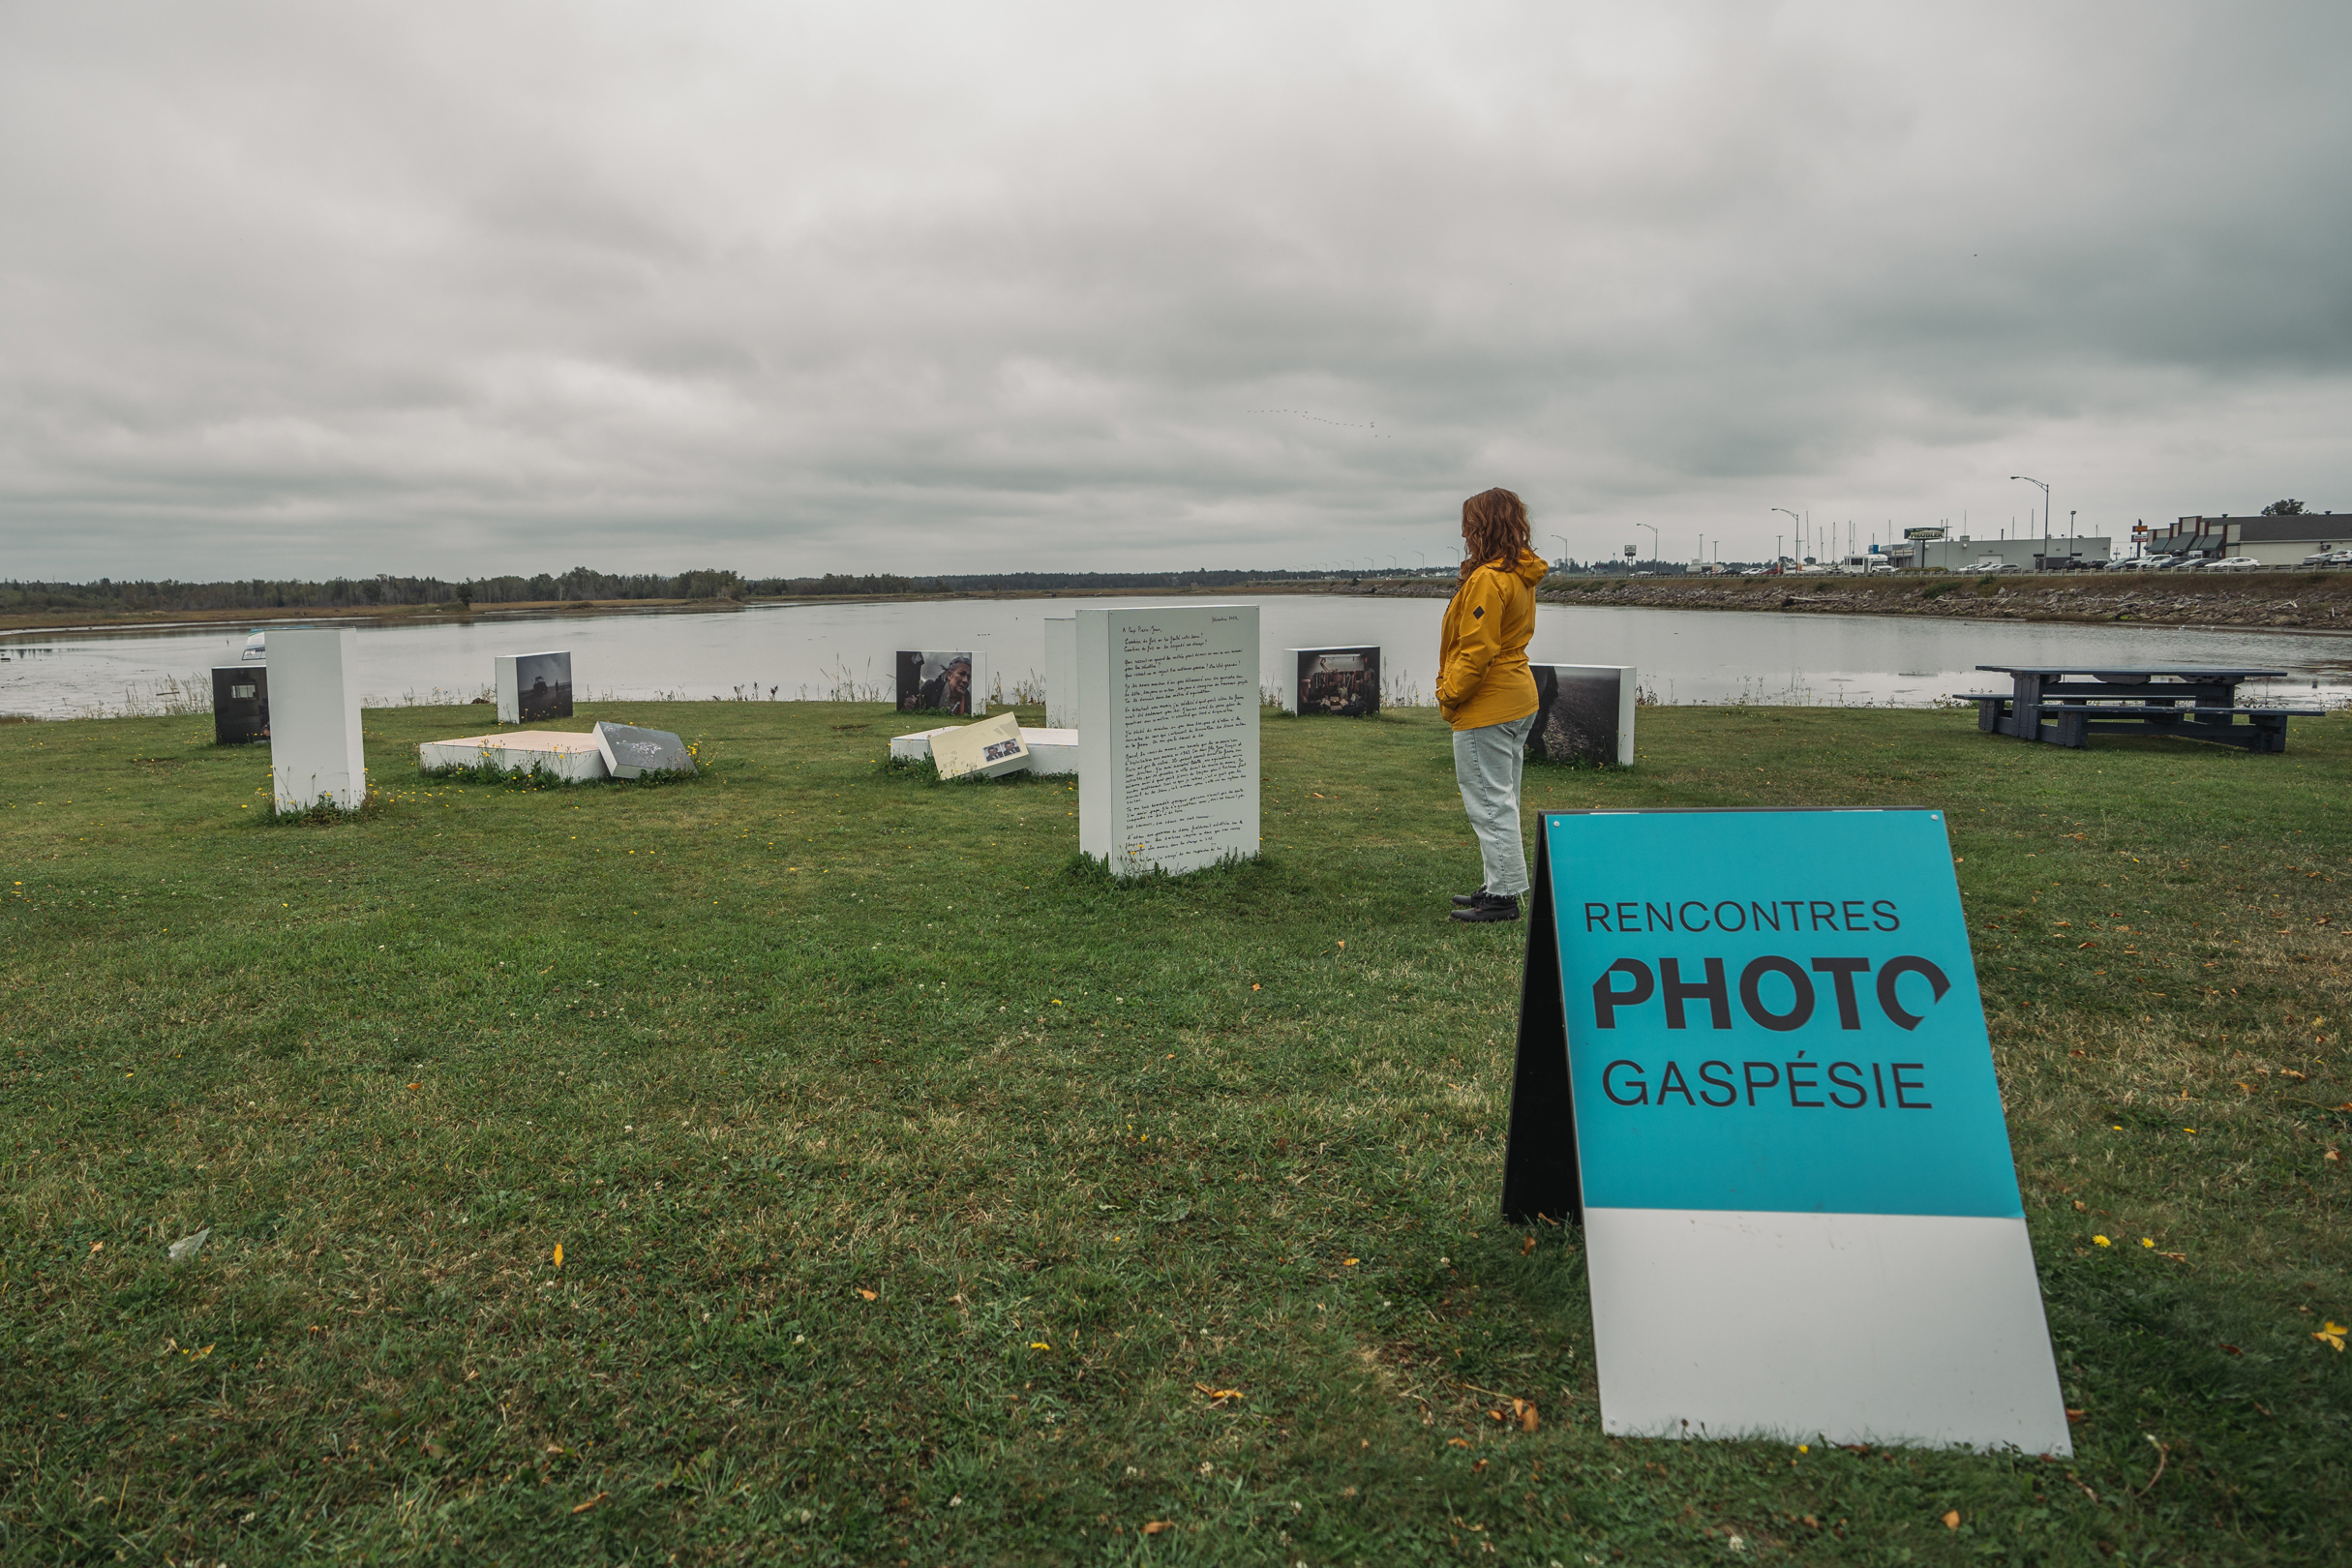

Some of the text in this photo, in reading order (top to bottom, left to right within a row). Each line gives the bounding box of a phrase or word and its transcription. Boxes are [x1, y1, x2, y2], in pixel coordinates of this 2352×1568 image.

[1584, 900, 1900, 932] RENCONTRES
[1593, 955, 1950, 1031] PHOTO
[1603, 1050, 1932, 1109] GASPÉSIE
